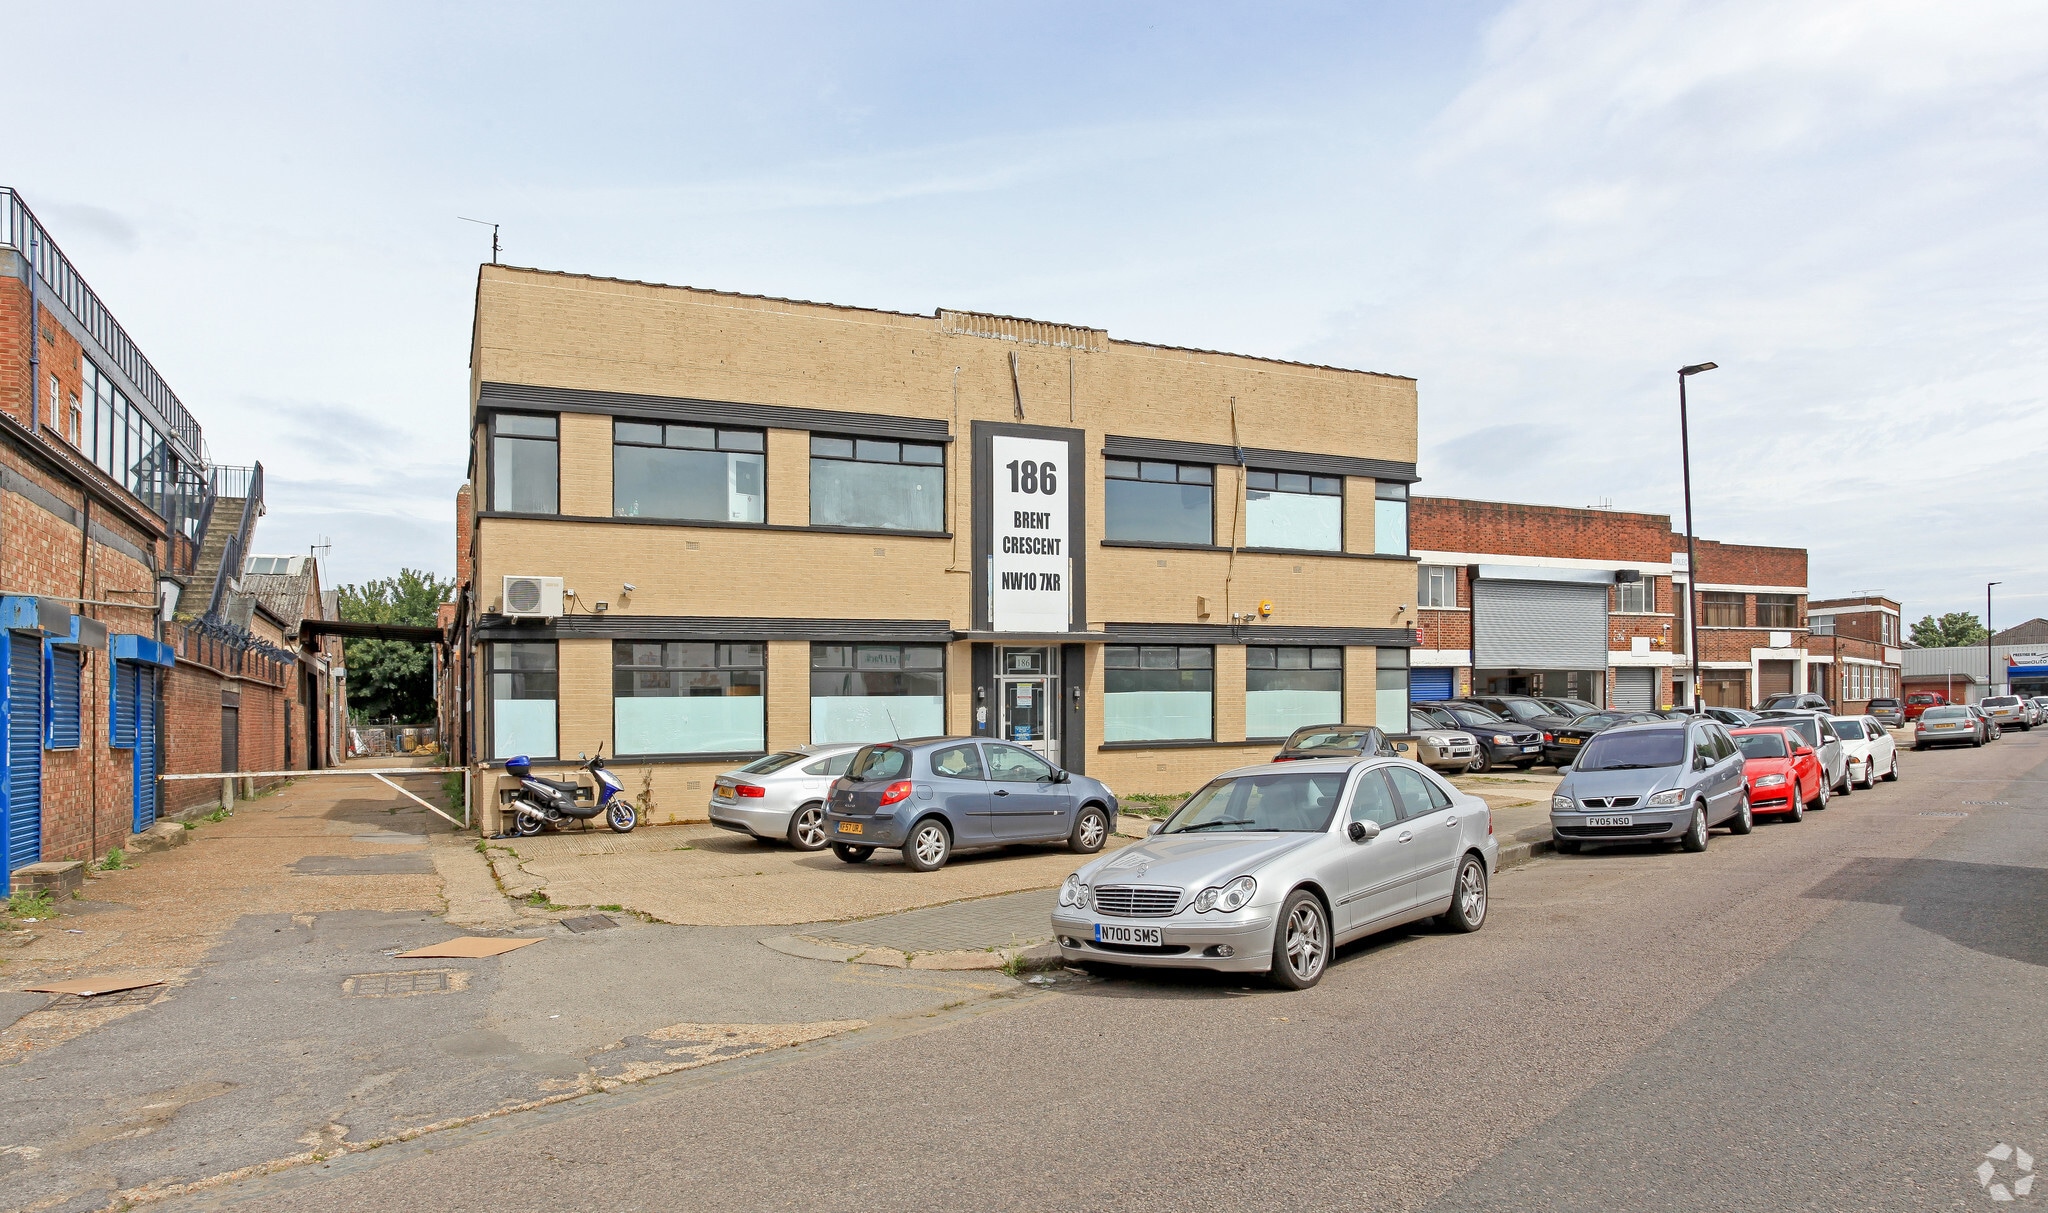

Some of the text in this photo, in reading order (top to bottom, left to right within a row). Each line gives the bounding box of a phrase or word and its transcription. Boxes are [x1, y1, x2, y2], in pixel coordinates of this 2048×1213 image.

[1006, 460, 1057, 495] 186
[1014, 511, 1050, 529] BRENT
[1002, 536, 1061, 555] CRESCENT
[1002, 572, 1061, 591] NW10 7XR
[1017, 659, 1030, 667] 186
[1612, 817, 1630, 825] NSO
[1102, 926, 1159, 943] N700 SMS
